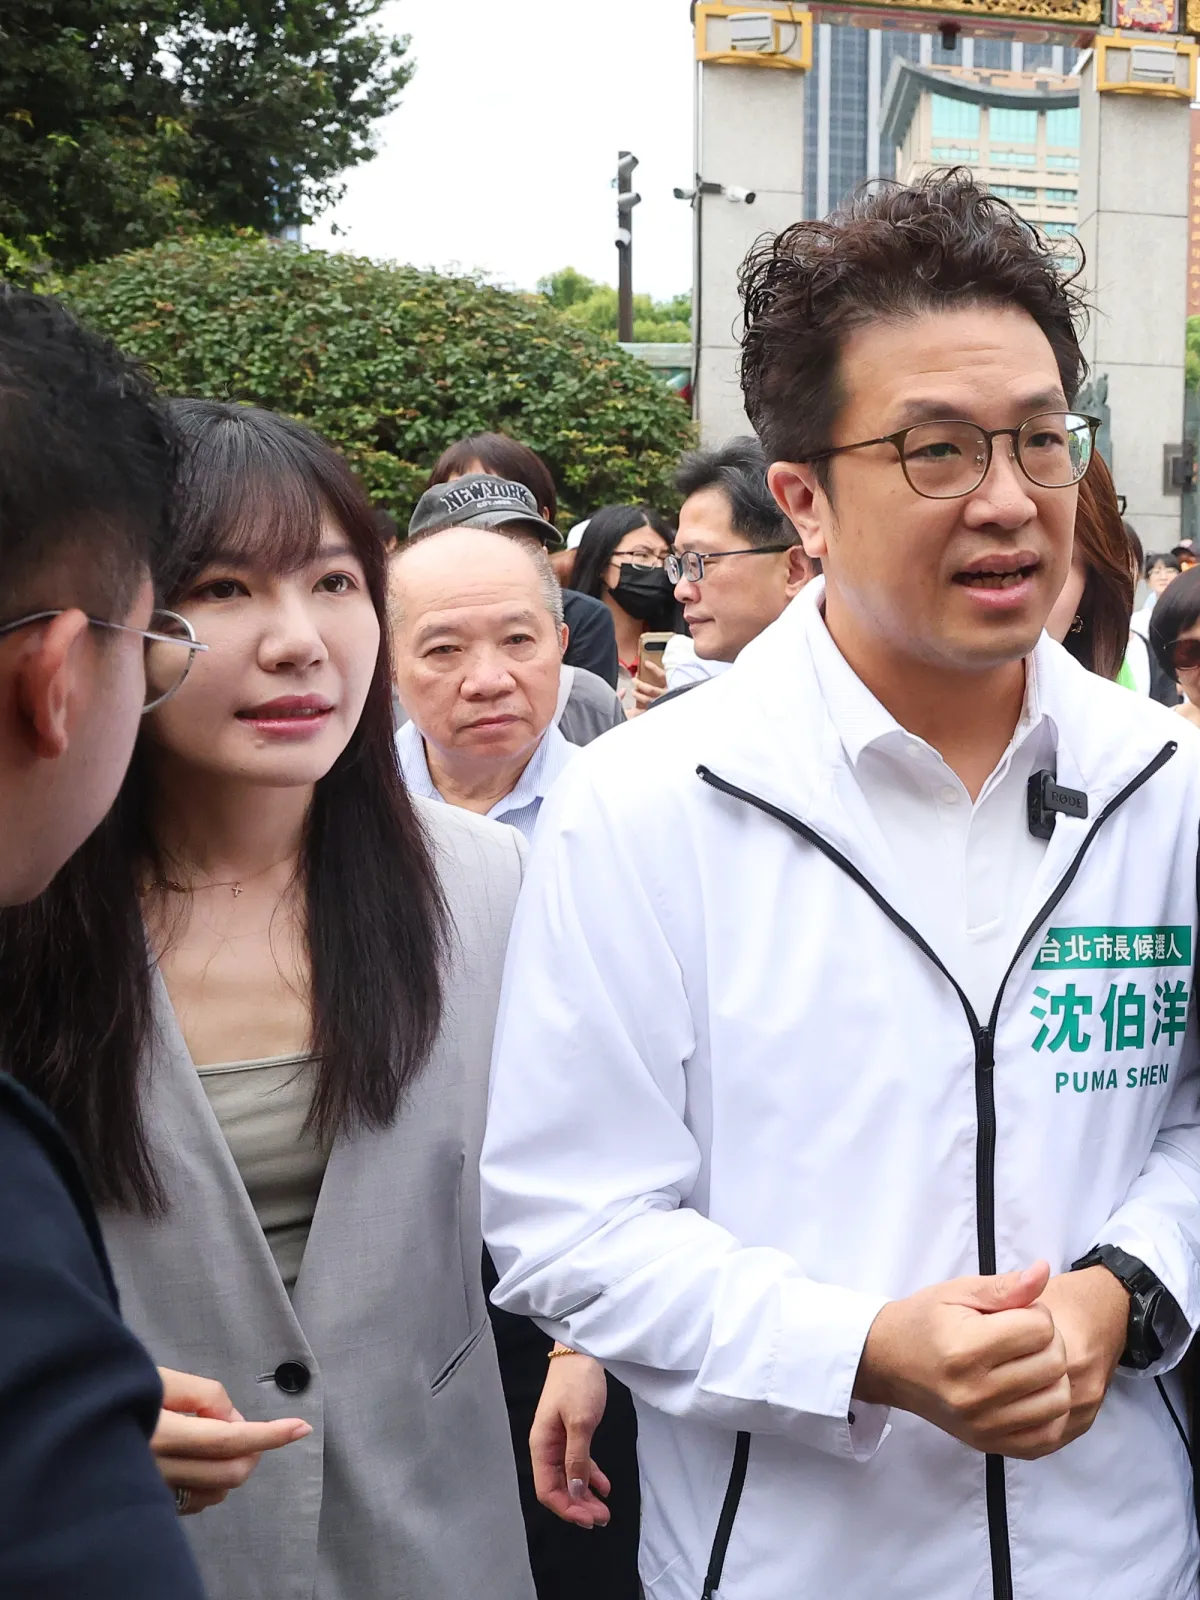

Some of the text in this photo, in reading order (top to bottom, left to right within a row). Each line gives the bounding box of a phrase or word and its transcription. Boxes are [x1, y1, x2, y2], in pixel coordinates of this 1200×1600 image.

[440, 482, 528, 514] NEW YORK
[1038, 932, 1183, 964] 台北市長候選人
[1029, 980, 1189, 1054] 沈伯洋
[1055, 1063, 1169, 1094] PUMA SHEN
